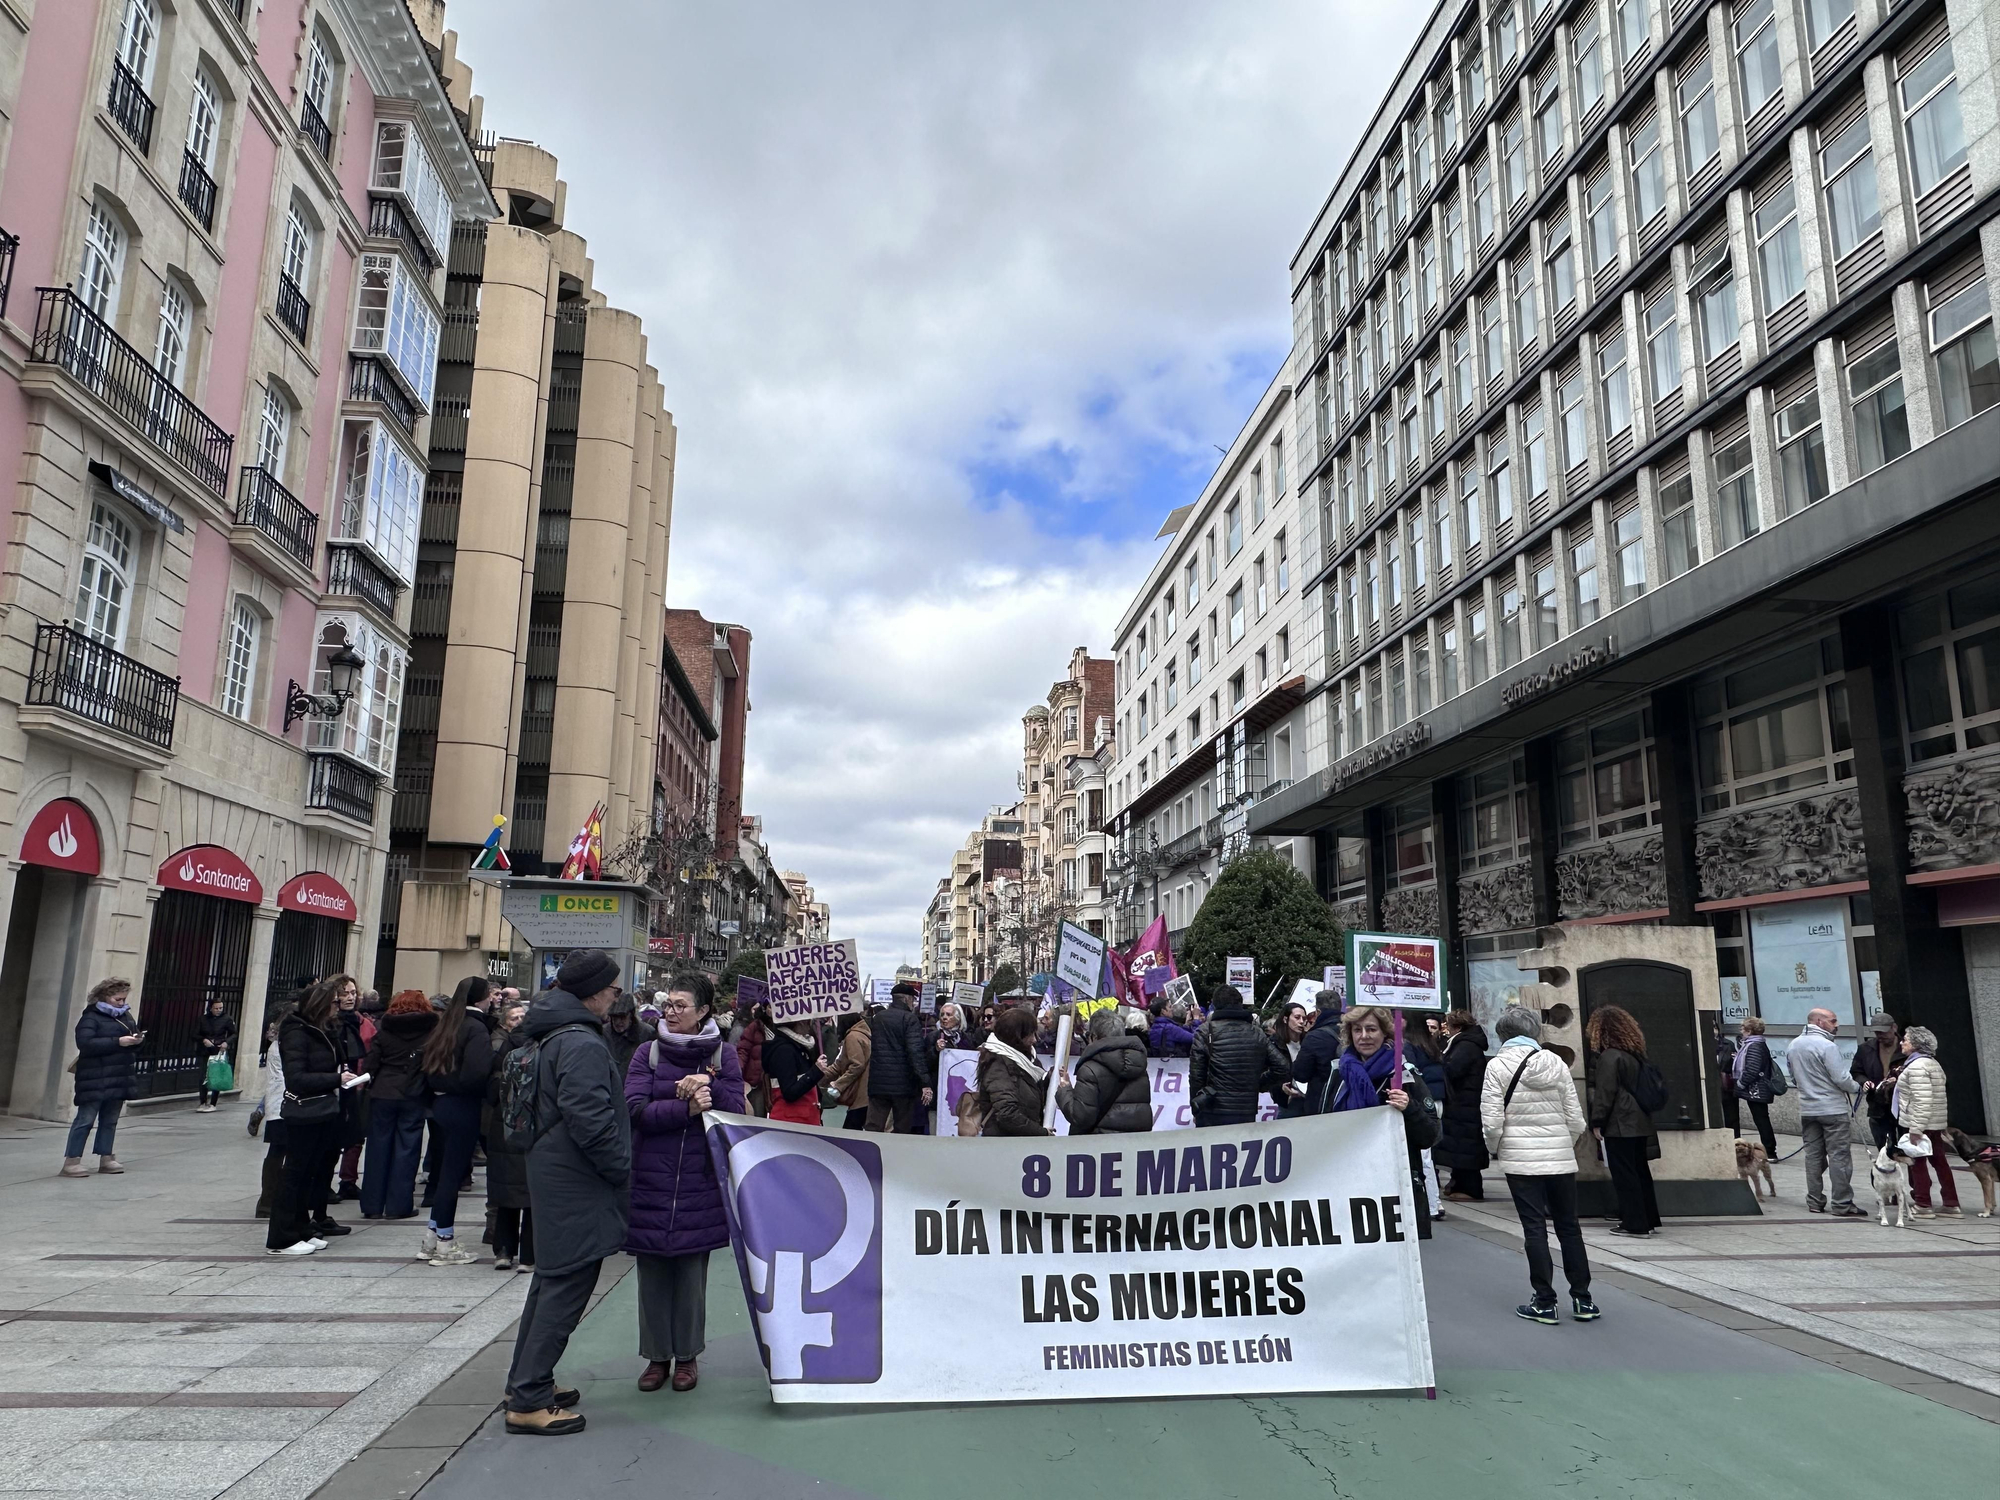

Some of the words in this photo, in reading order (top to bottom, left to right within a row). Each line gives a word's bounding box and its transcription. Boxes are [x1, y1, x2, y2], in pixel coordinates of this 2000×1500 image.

[1501, 674, 1543, 705] Edificio
[1548, 643, 1599, 683] Ordoño
[195, 863, 251, 892] Santander
[307, 888, 347, 911] Santander
[564, 898, 613, 911] ONCE
[767, 943, 846, 969] MUJERES
[1365, 956, 1377, 971] LEY
[1375, 949, 1429, 979] ABOLICIONISTA
[769, 961, 856, 986] AFGANAS
[770, 977, 858, 1003] RESISTIMOS
[775, 993, 852, 1019] JUNTAS
[1153, 1068, 1180, 1094] la
[1021, 1154, 1051, 1199] 8
[1066, 1152, 1123, 1198] DE
[1136, 1136, 1293, 1196] MARZO
[914, 1200, 990, 1256] DÍA
[1000, 1197, 1341, 1255] INTERNACIONAL
[1350, 1196, 1405, 1246] DE
[1021, 1273, 1100, 1324] LAS
[1109, 1267, 1306, 1321] MUJERES
[1043, 1341, 1191, 1371] FEMINISTAS
[1197, 1340, 1229, 1365] DE
[1232, 1333, 1293, 1363] LEÓN
